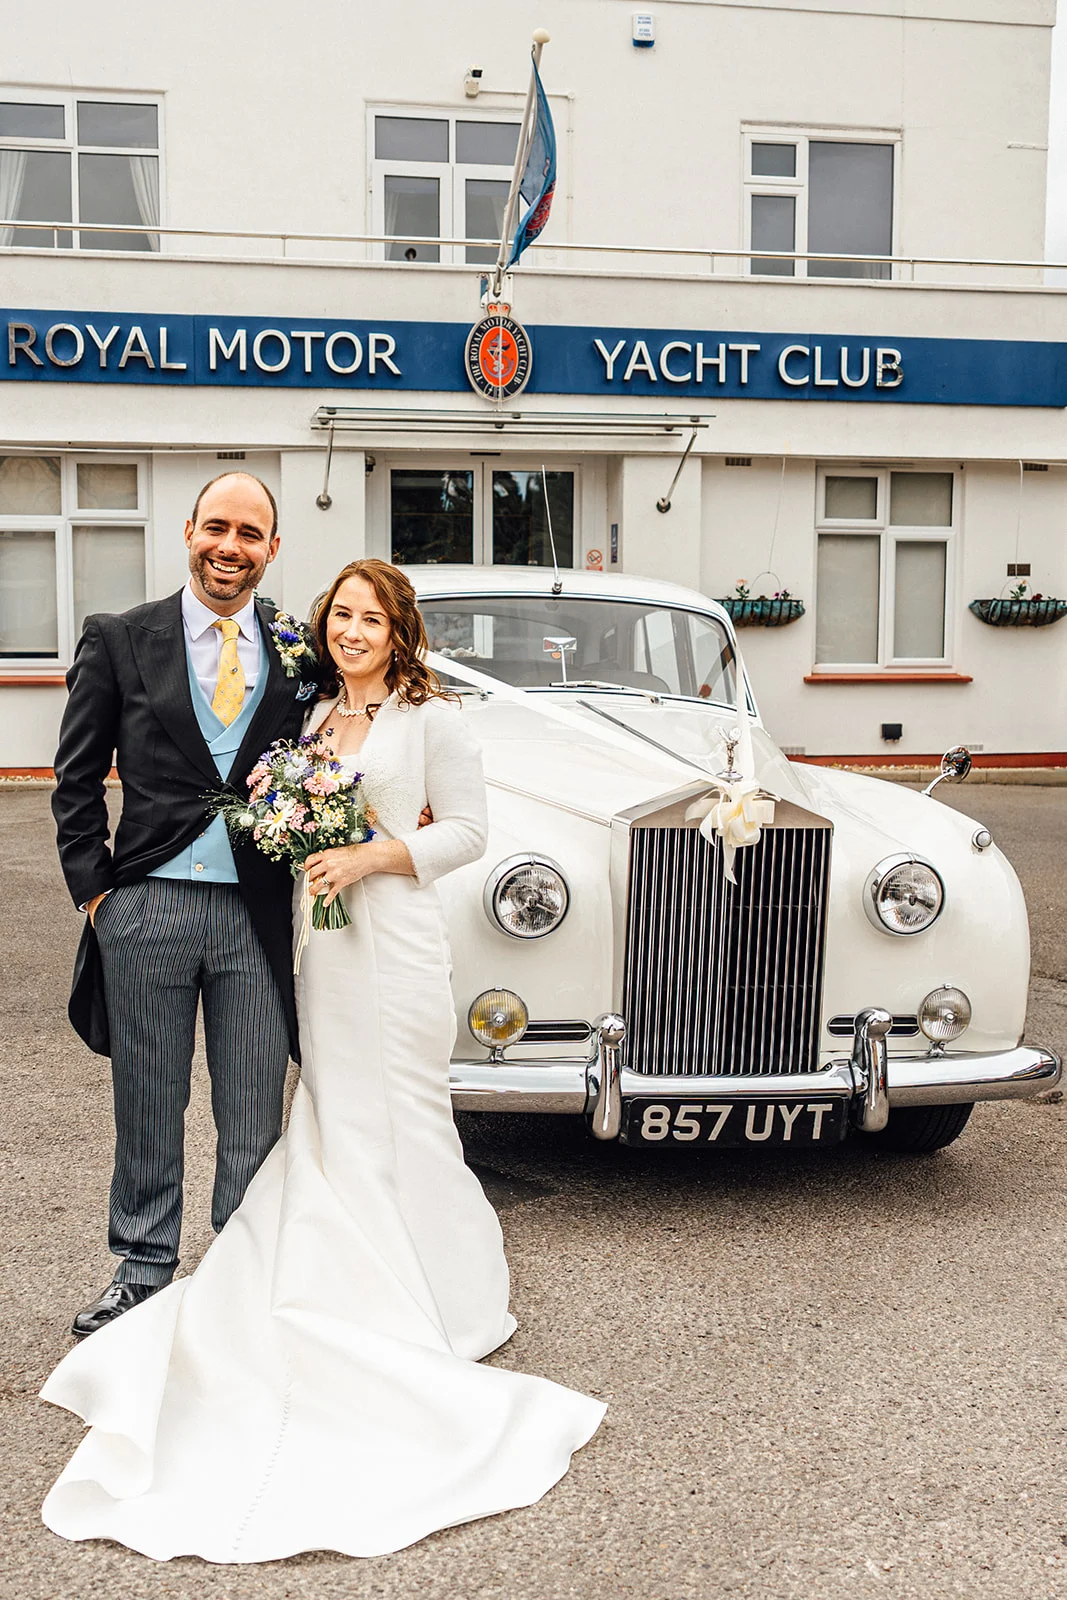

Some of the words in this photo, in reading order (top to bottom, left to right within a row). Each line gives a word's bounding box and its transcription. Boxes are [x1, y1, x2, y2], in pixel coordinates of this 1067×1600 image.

[480, 317, 513, 330] MOTOR
[7, 322, 187, 370] ROYAL
[209, 328, 401, 375] MOTOR
[594, 339, 761, 383] YACHT
[778, 345, 904, 387] CLUB
[470, 332, 483, 361] ROYAL
[512, 327, 528, 358] YACHT
[471, 361, 483, 382] THE
[513, 359, 528, 385] CLUB
[640, 1104, 733, 1141] 857
[745, 1103, 833, 1141] UYT
